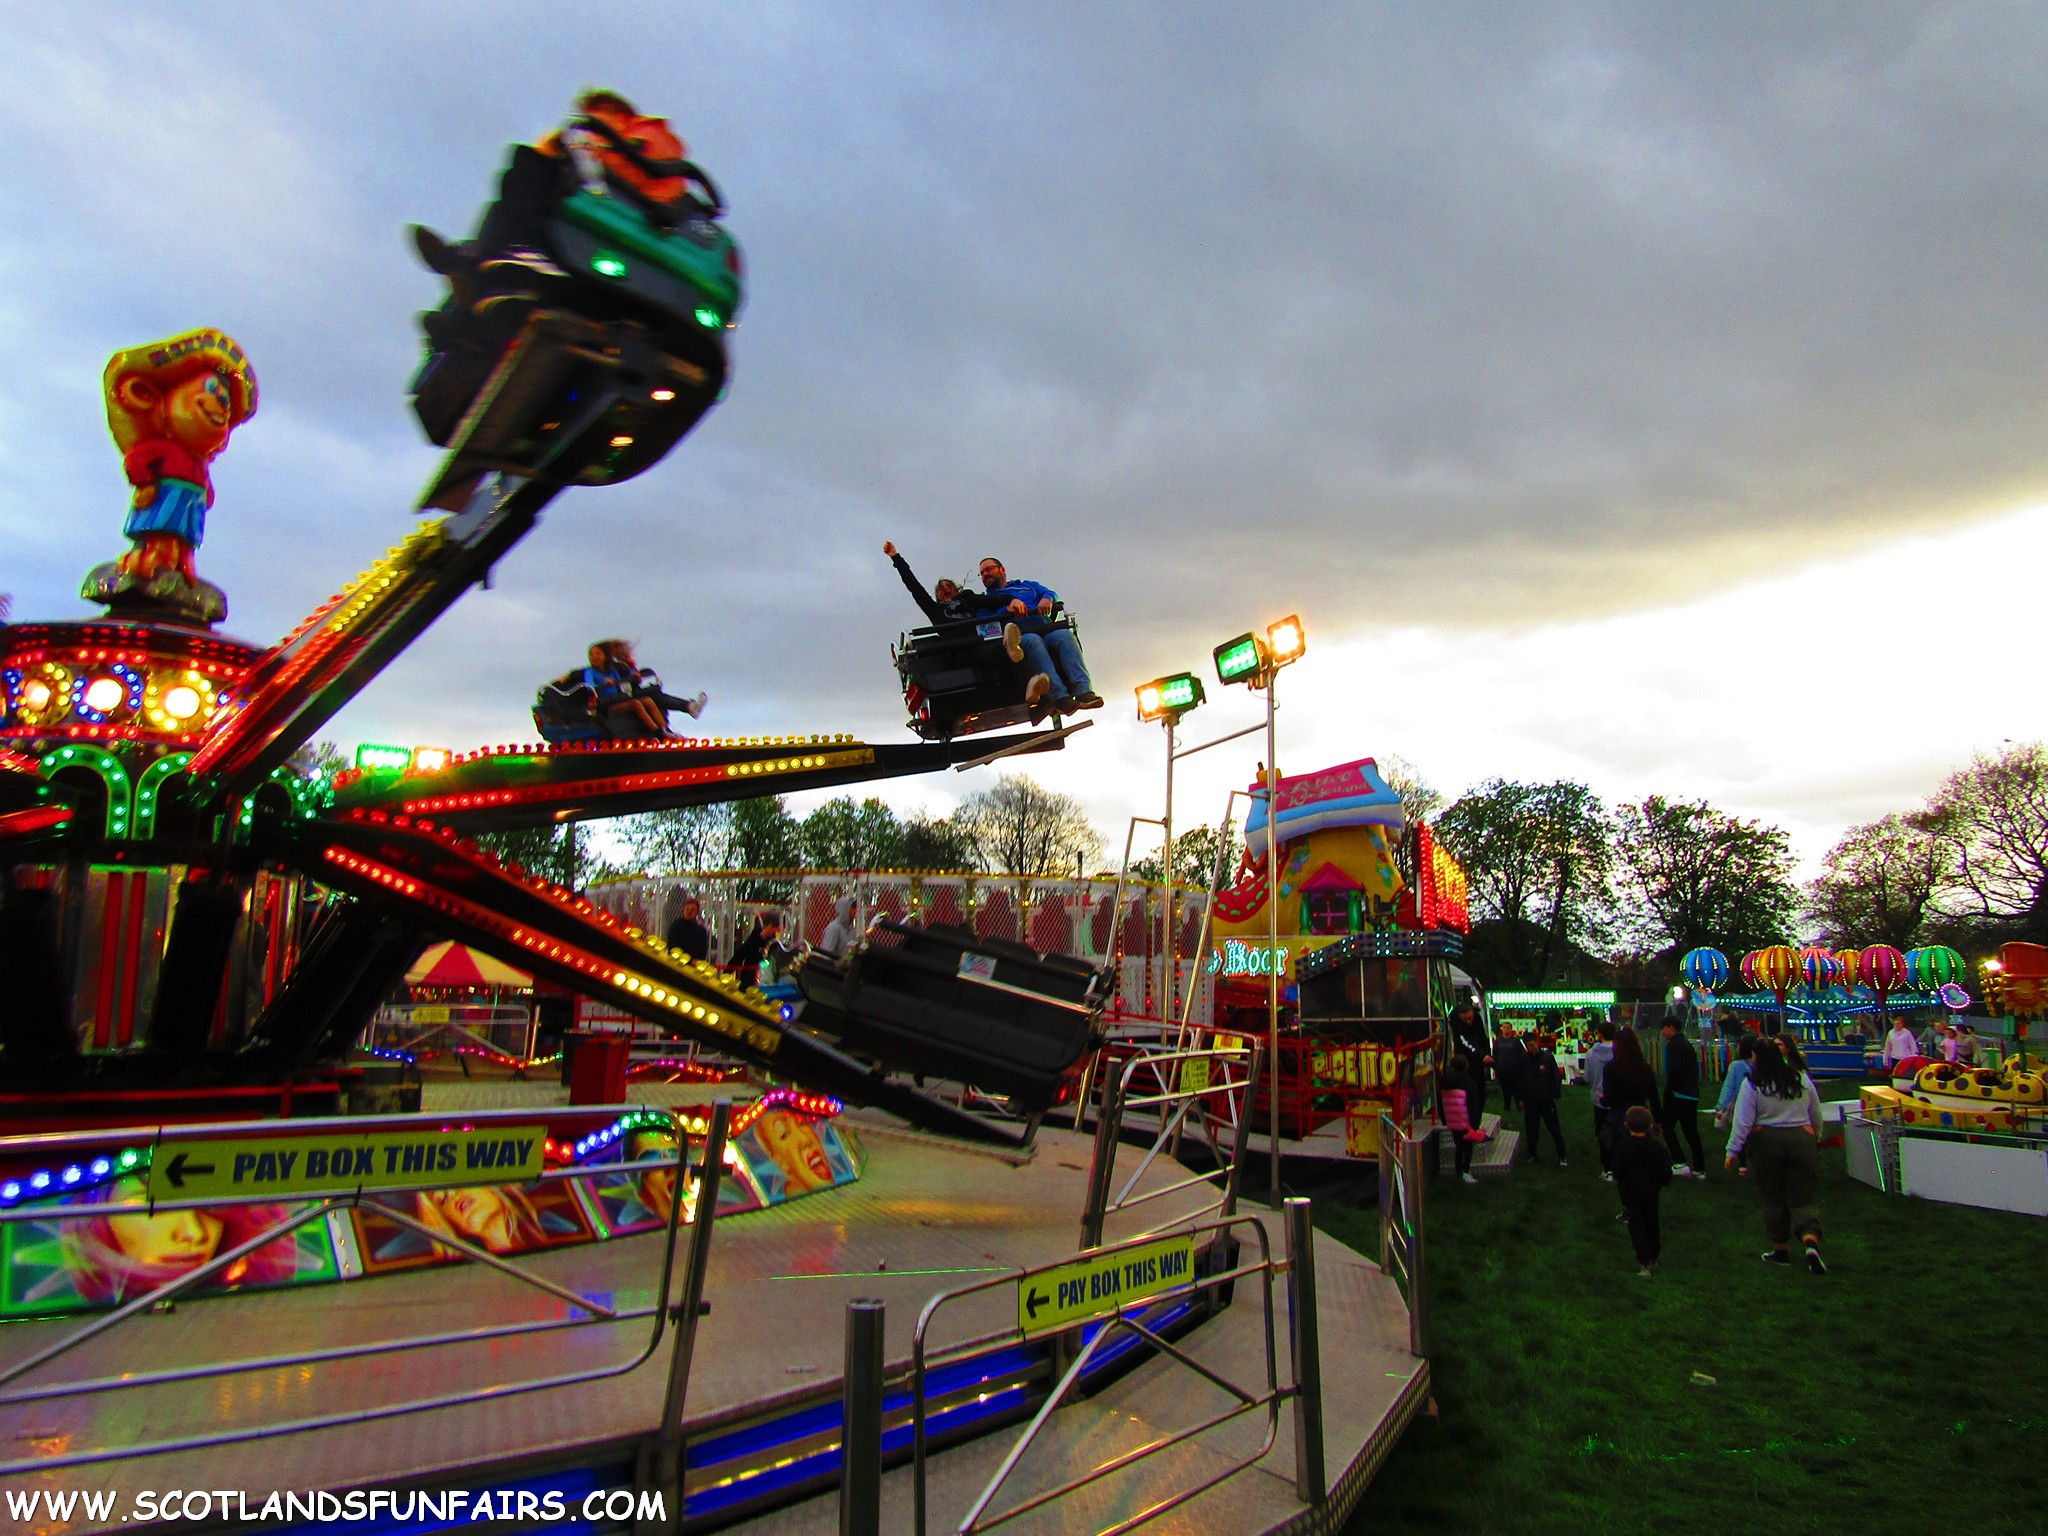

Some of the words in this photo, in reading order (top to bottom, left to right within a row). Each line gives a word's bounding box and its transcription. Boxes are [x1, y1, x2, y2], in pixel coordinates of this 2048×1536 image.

[233, 1151, 298, 1184] PAY
[305, 1143, 375, 1179] BOX
[383, 1139, 458, 1174] THIS
[466, 1138, 534, 1169] WAY
[1058, 1277, 1087, 1309] PAY
[1091, 1267, 1121, 1300] BOX
[1124, 1258, 1157, 1290] THIS
[1159, 1248, 1189, 1279] WAY
